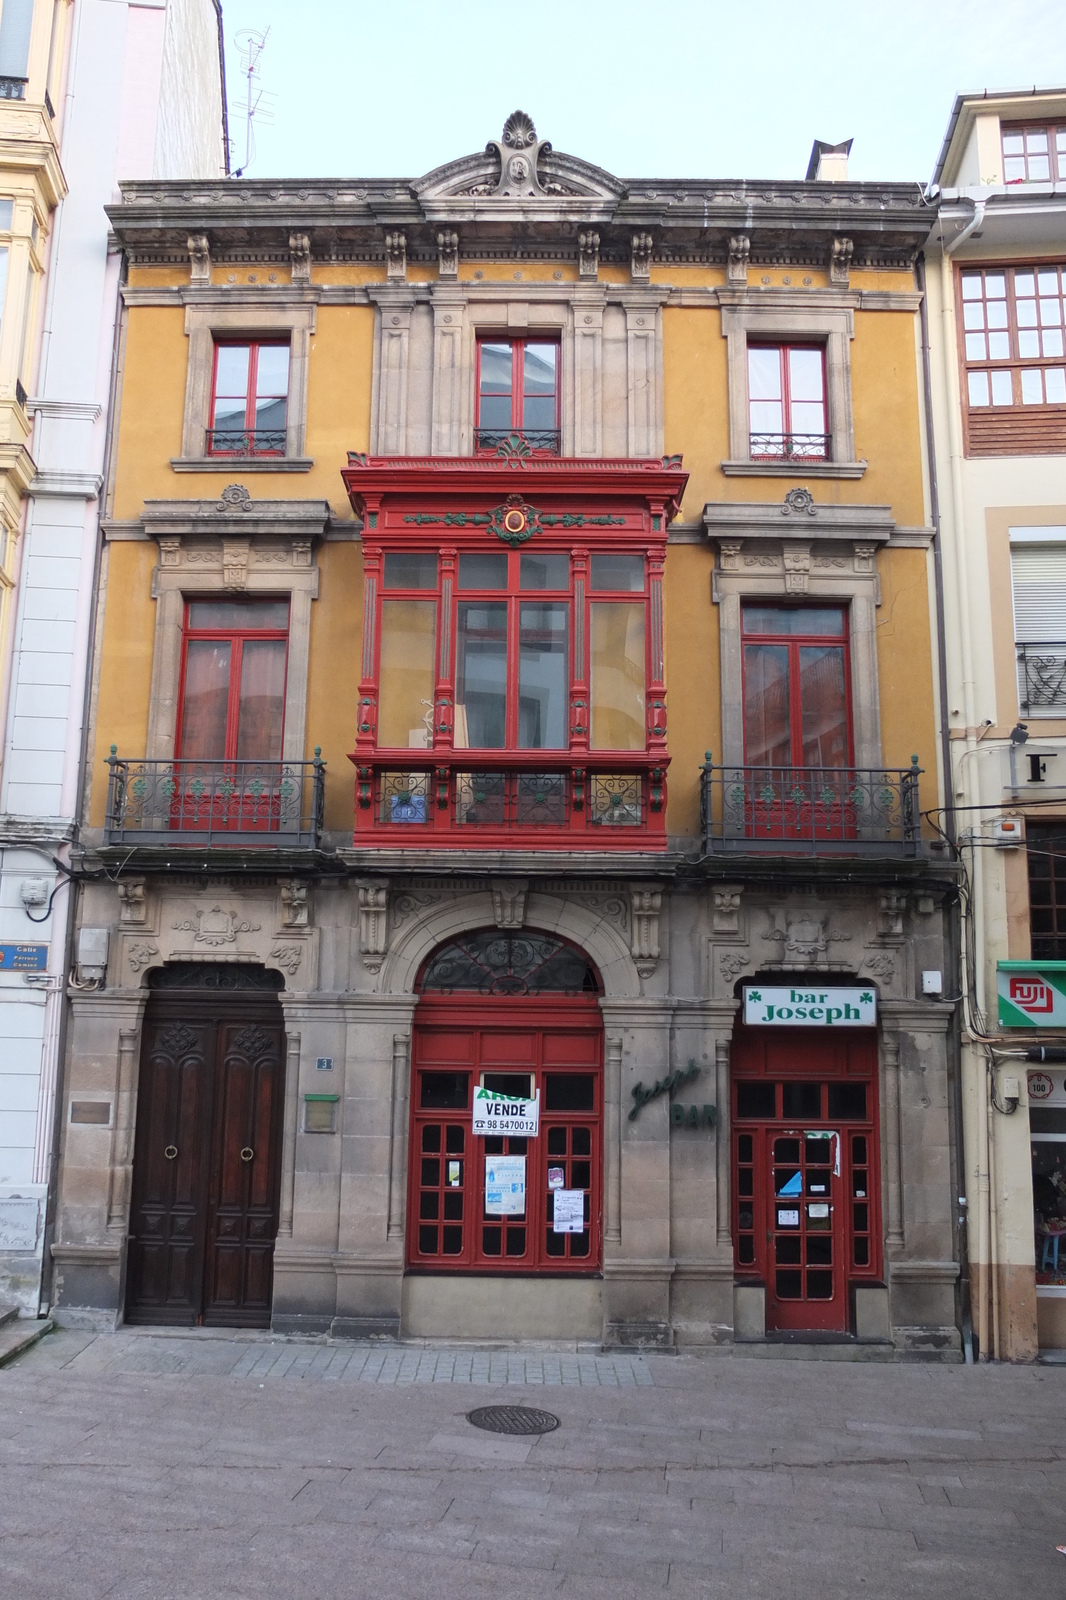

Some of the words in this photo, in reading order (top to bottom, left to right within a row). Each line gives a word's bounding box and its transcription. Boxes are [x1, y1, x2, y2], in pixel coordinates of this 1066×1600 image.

[790, 990, 828, 1003] bar
[1010, 978, 1049, 1008] FUJI
[761, 1003, 861, 1024] Joseph
[322, 1059, 328, 1069] 3
[628, 1056, 701, 1121] Joseph
[1032, 1084, 1046, 1092] 100
[486, 1103, 526, 1116] VENDE
[671, 1103, 718, 1128] BAR
[487, 1120, 498, 1129] 98
